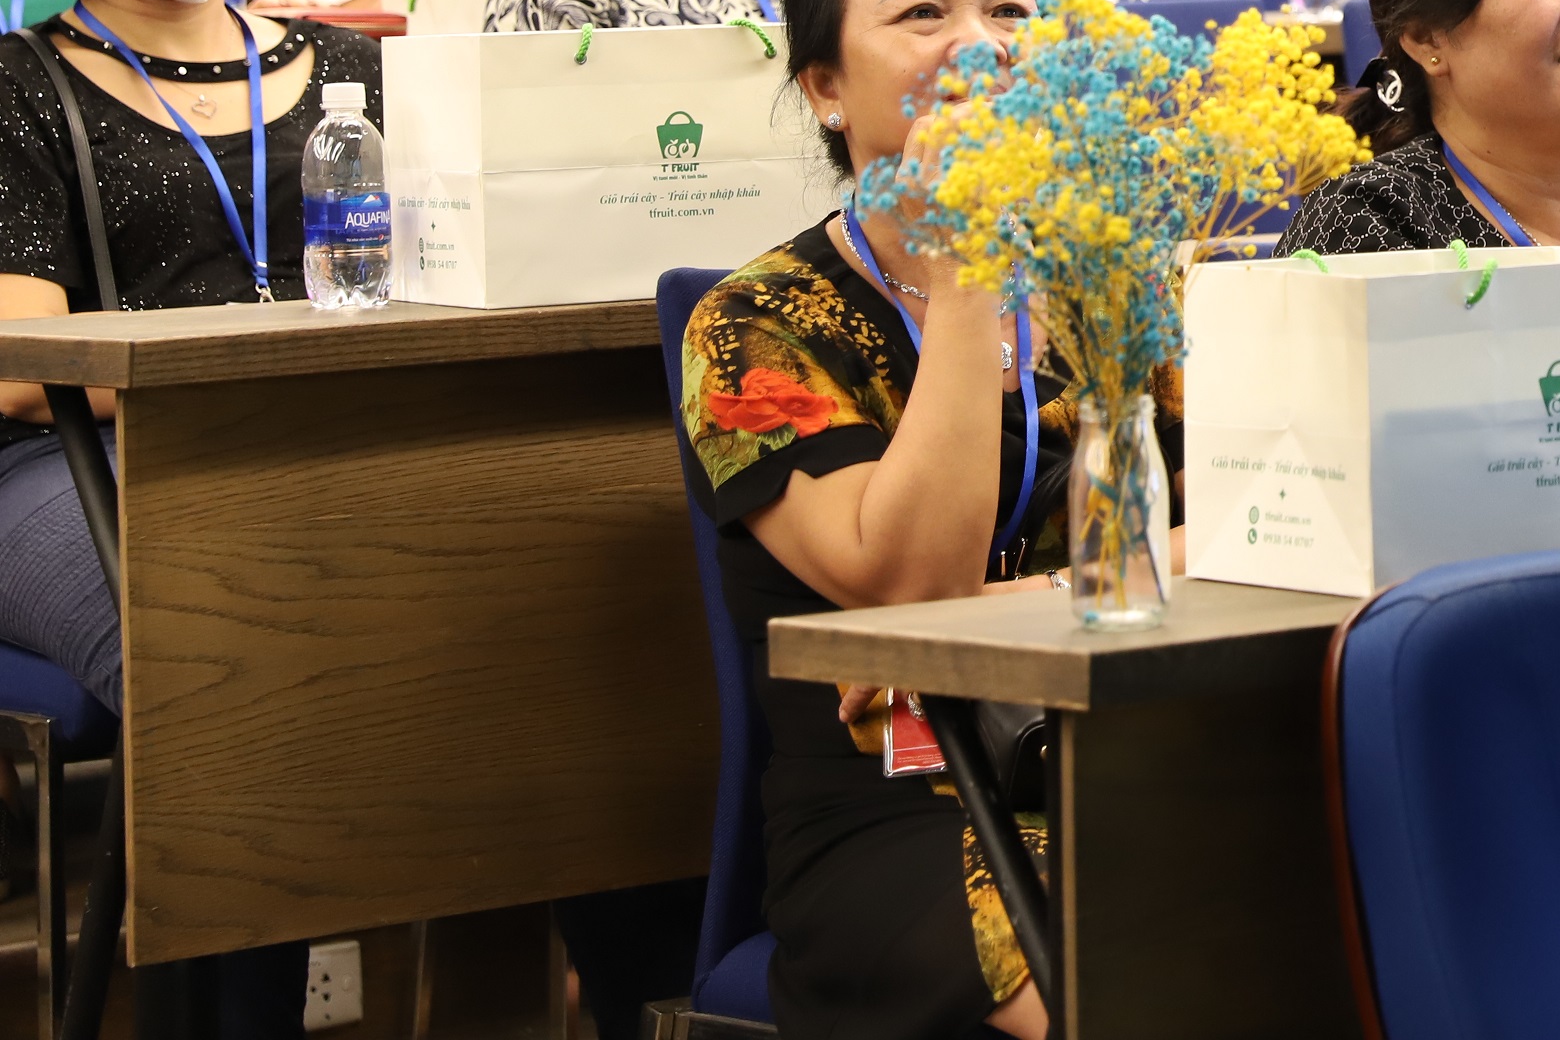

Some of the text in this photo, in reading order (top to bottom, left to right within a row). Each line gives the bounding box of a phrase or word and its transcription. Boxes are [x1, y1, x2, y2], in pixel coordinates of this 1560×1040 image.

[661, 163, 700, 173] T FRUIT
[620, 192, 639, 204] trái
[641, 192, 657, 203] cây
[667, 189, 688, 201] Trái
[691, 190, 707, 202] cây
[709, 187, 735, 202] nhập
[649, 208, 714, 219] tfruit.com.vn
[1547, 422, 1554, 433] T
